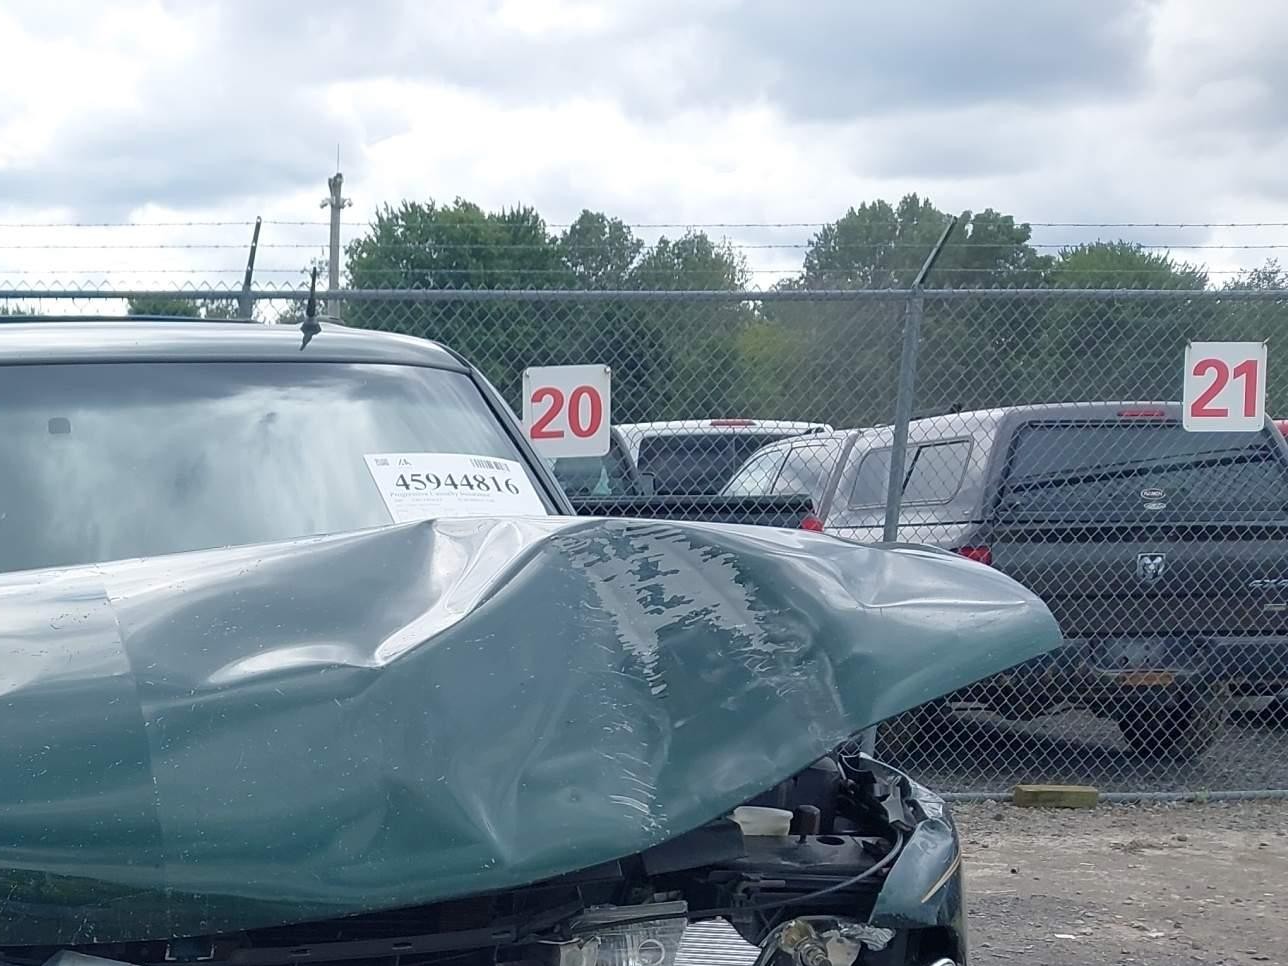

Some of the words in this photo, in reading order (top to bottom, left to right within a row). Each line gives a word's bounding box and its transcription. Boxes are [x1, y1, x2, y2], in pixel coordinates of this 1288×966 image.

[530, 385, 602, 439] 20
[1191, 358, 1258, 417] 21
[395, 472, 519, 495] 45944816
